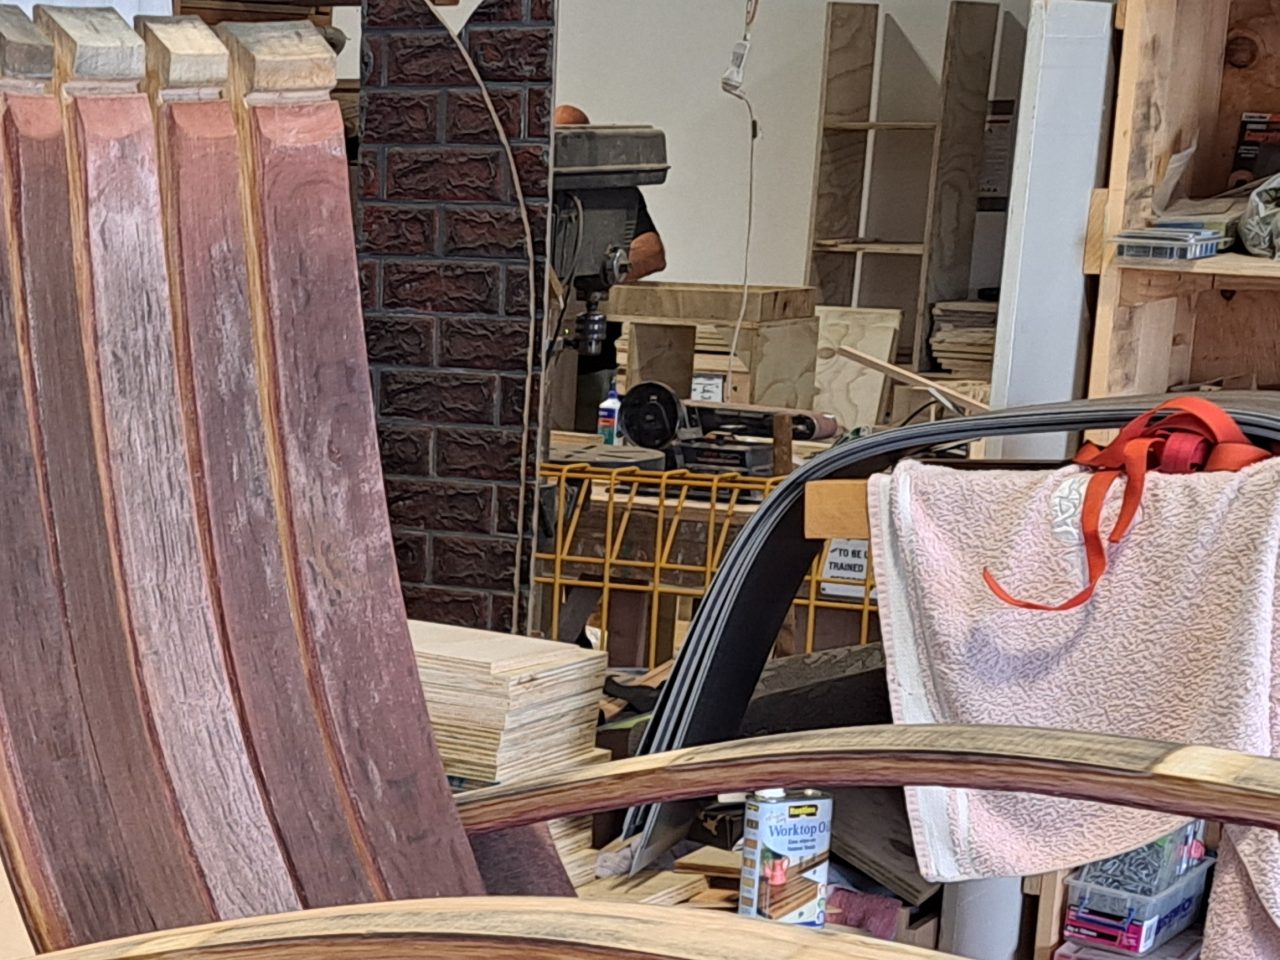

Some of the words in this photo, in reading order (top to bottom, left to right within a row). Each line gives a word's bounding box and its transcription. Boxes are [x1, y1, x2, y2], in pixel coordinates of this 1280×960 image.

[838, 548, 849, 558] TO
[851, 549, 862, 559] BE
[829, 561, 864, 573] TRAINED
[769, 823, 817, 838] Worktop
